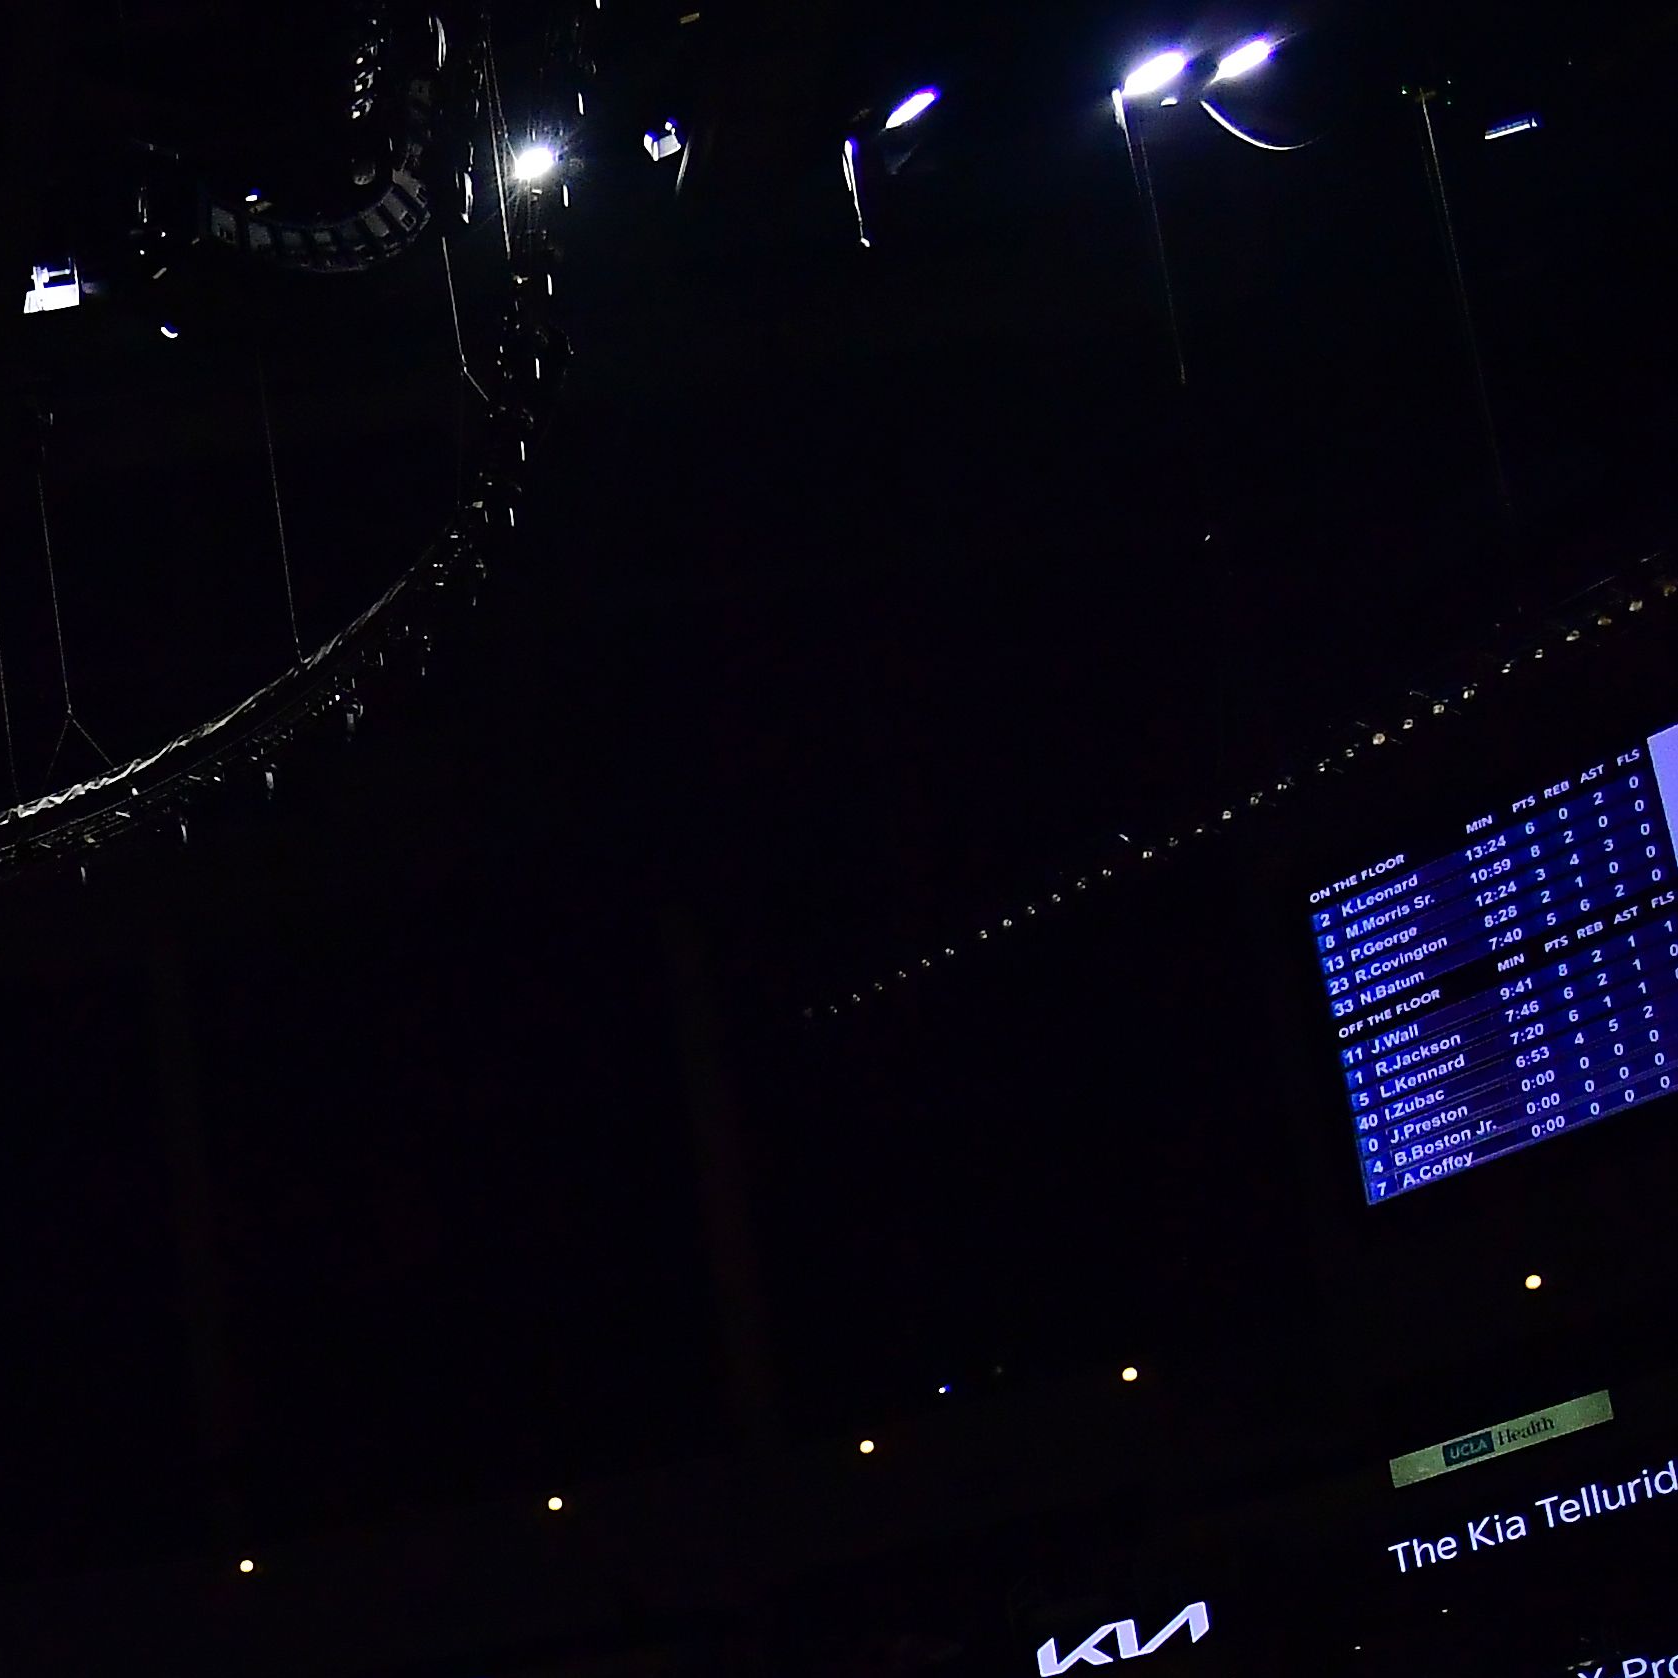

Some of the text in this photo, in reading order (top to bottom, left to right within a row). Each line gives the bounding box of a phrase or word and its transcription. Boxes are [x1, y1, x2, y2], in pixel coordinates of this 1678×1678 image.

[1465, 835, 1506, 862] 13:24
[1309, 854, 1405, 904] ON THE FLOOR
[1470, 858, 1511, 884] 10:59
[1475, 880, 1517, 907] 12:24
[1354, 936, 1448, 984] R.Covington
[1359, 971, 1425, 1006] N.Batum
[1370, 1023, 1419, 1054] J.Wall
[1375, 1033, 1461, 1077] R.Jackson
[1384, 1089, 1445, 1121] I.Zubac
[1449, 1439, 1488, 1460] UCLA
[1388, 1537, 1457, 1572] The
[1468, 1515, 1526, 1550] Kia
